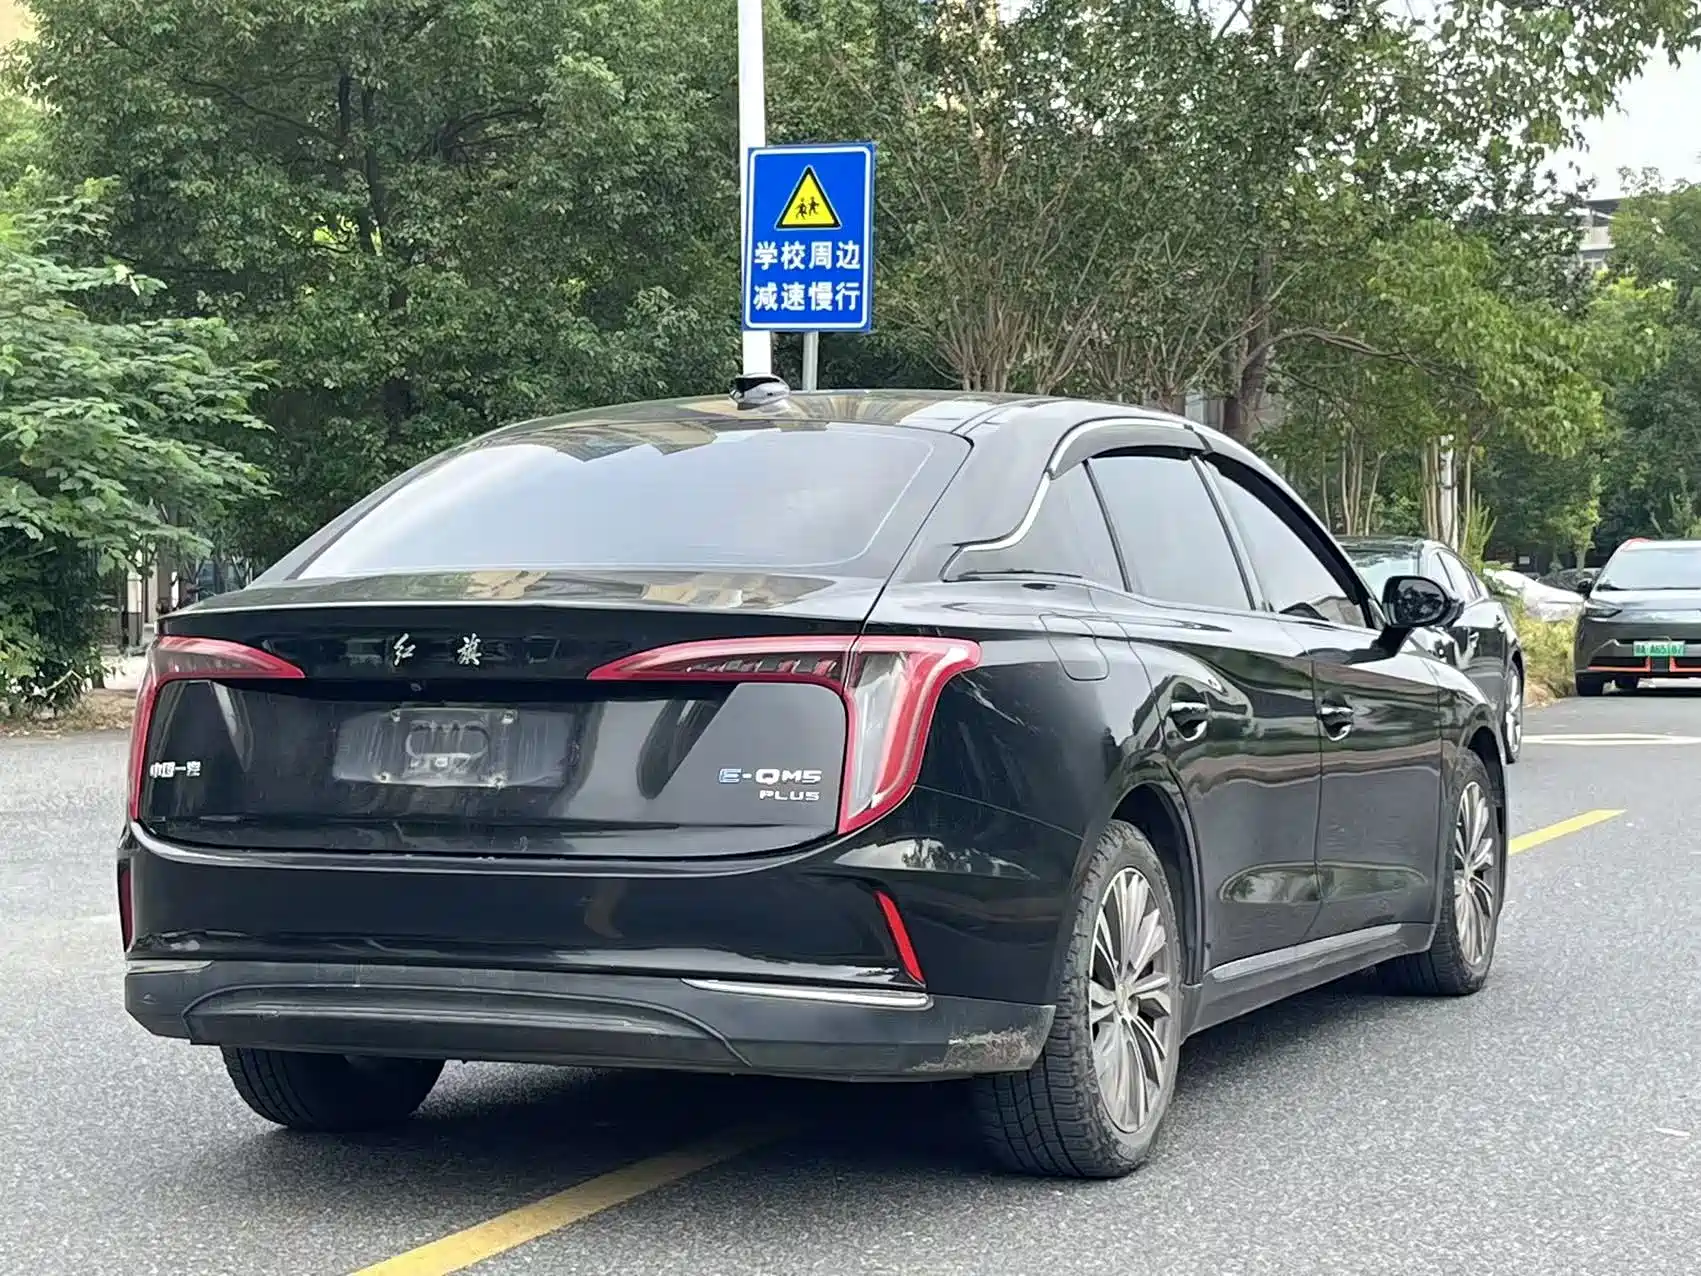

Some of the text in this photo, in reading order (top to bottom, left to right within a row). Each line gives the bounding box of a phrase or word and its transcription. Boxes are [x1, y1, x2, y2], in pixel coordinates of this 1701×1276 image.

[754, 240, 861, 270] 学校周边
[753, 281, 861, 311] 减速慢行
[719, 768, 823, 785] E-QM5
[759, 789, 820, 801] PLUS
